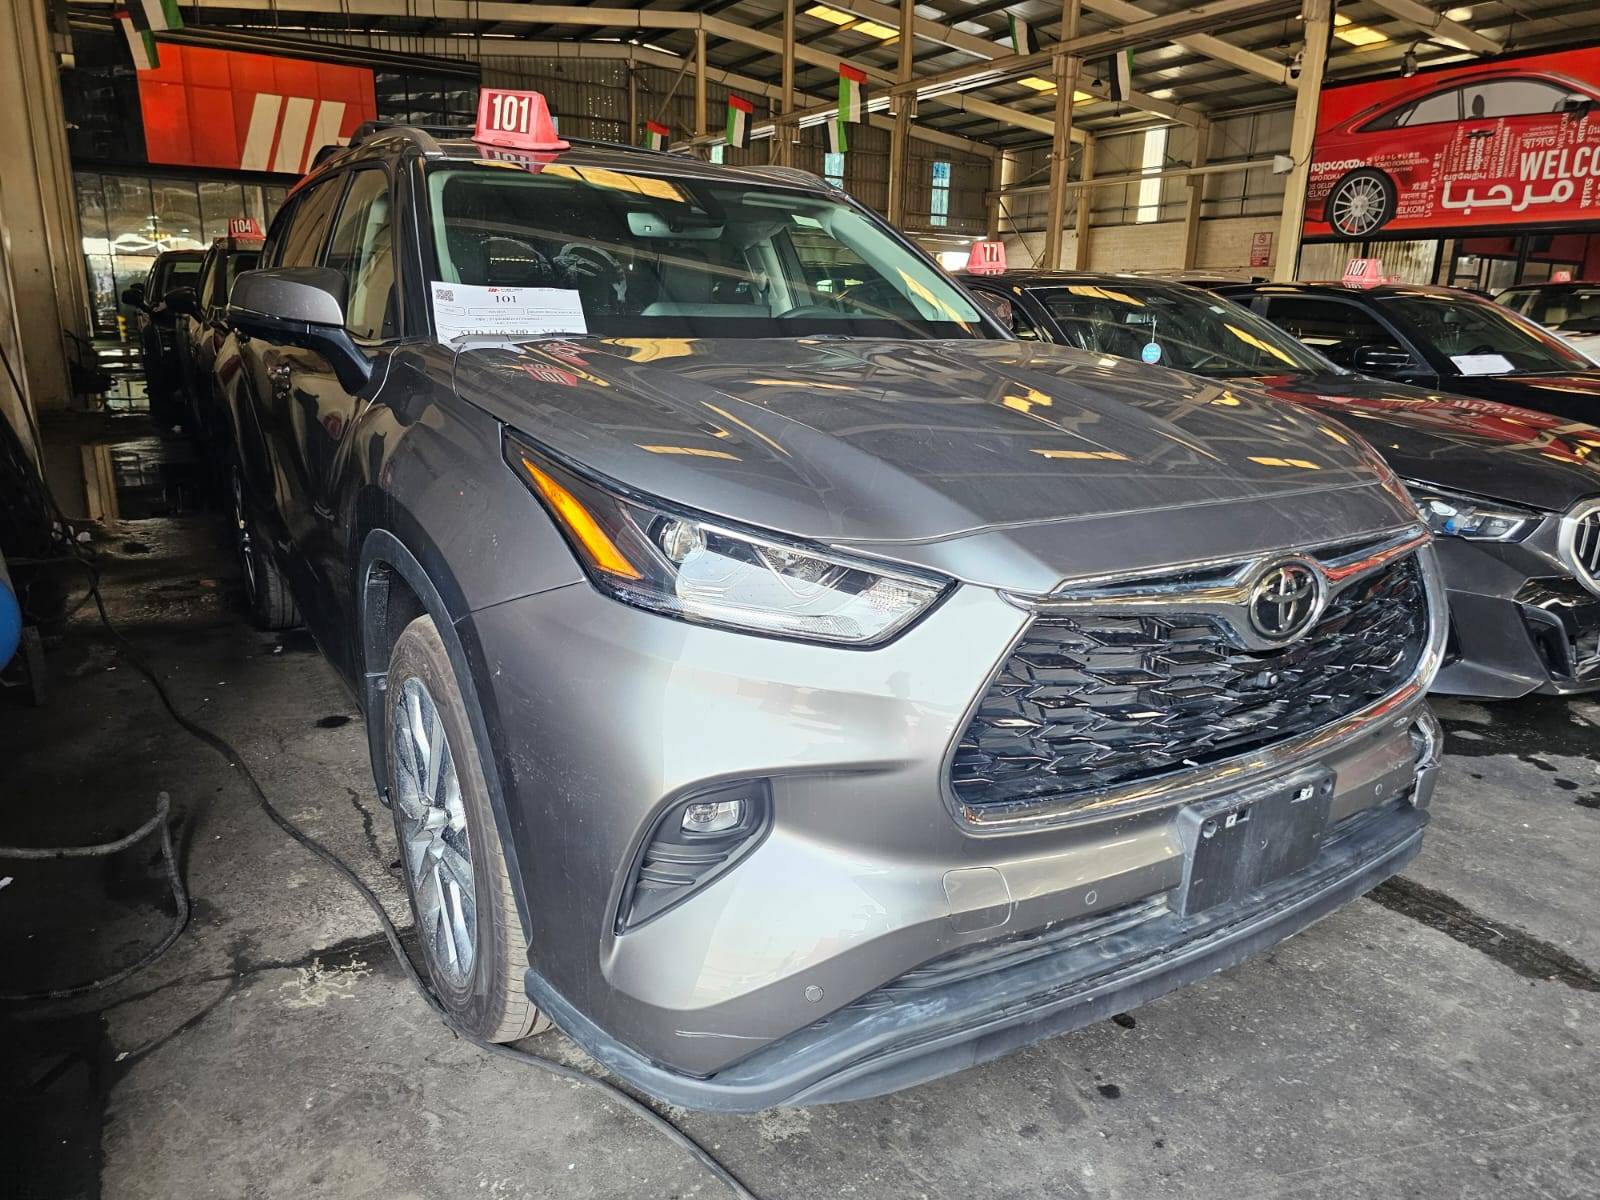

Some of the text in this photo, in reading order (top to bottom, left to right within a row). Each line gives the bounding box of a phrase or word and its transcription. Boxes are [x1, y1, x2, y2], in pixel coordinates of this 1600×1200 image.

[492, 95, 530, 133] 101
[1442, 180, 1574, 215] مرحبا
[233, 219, 252, 233] 104
[984, 243, 998, 261] 77
[1349, 260, 1368, 276] 107
[495, 295, 517, 303] 101
